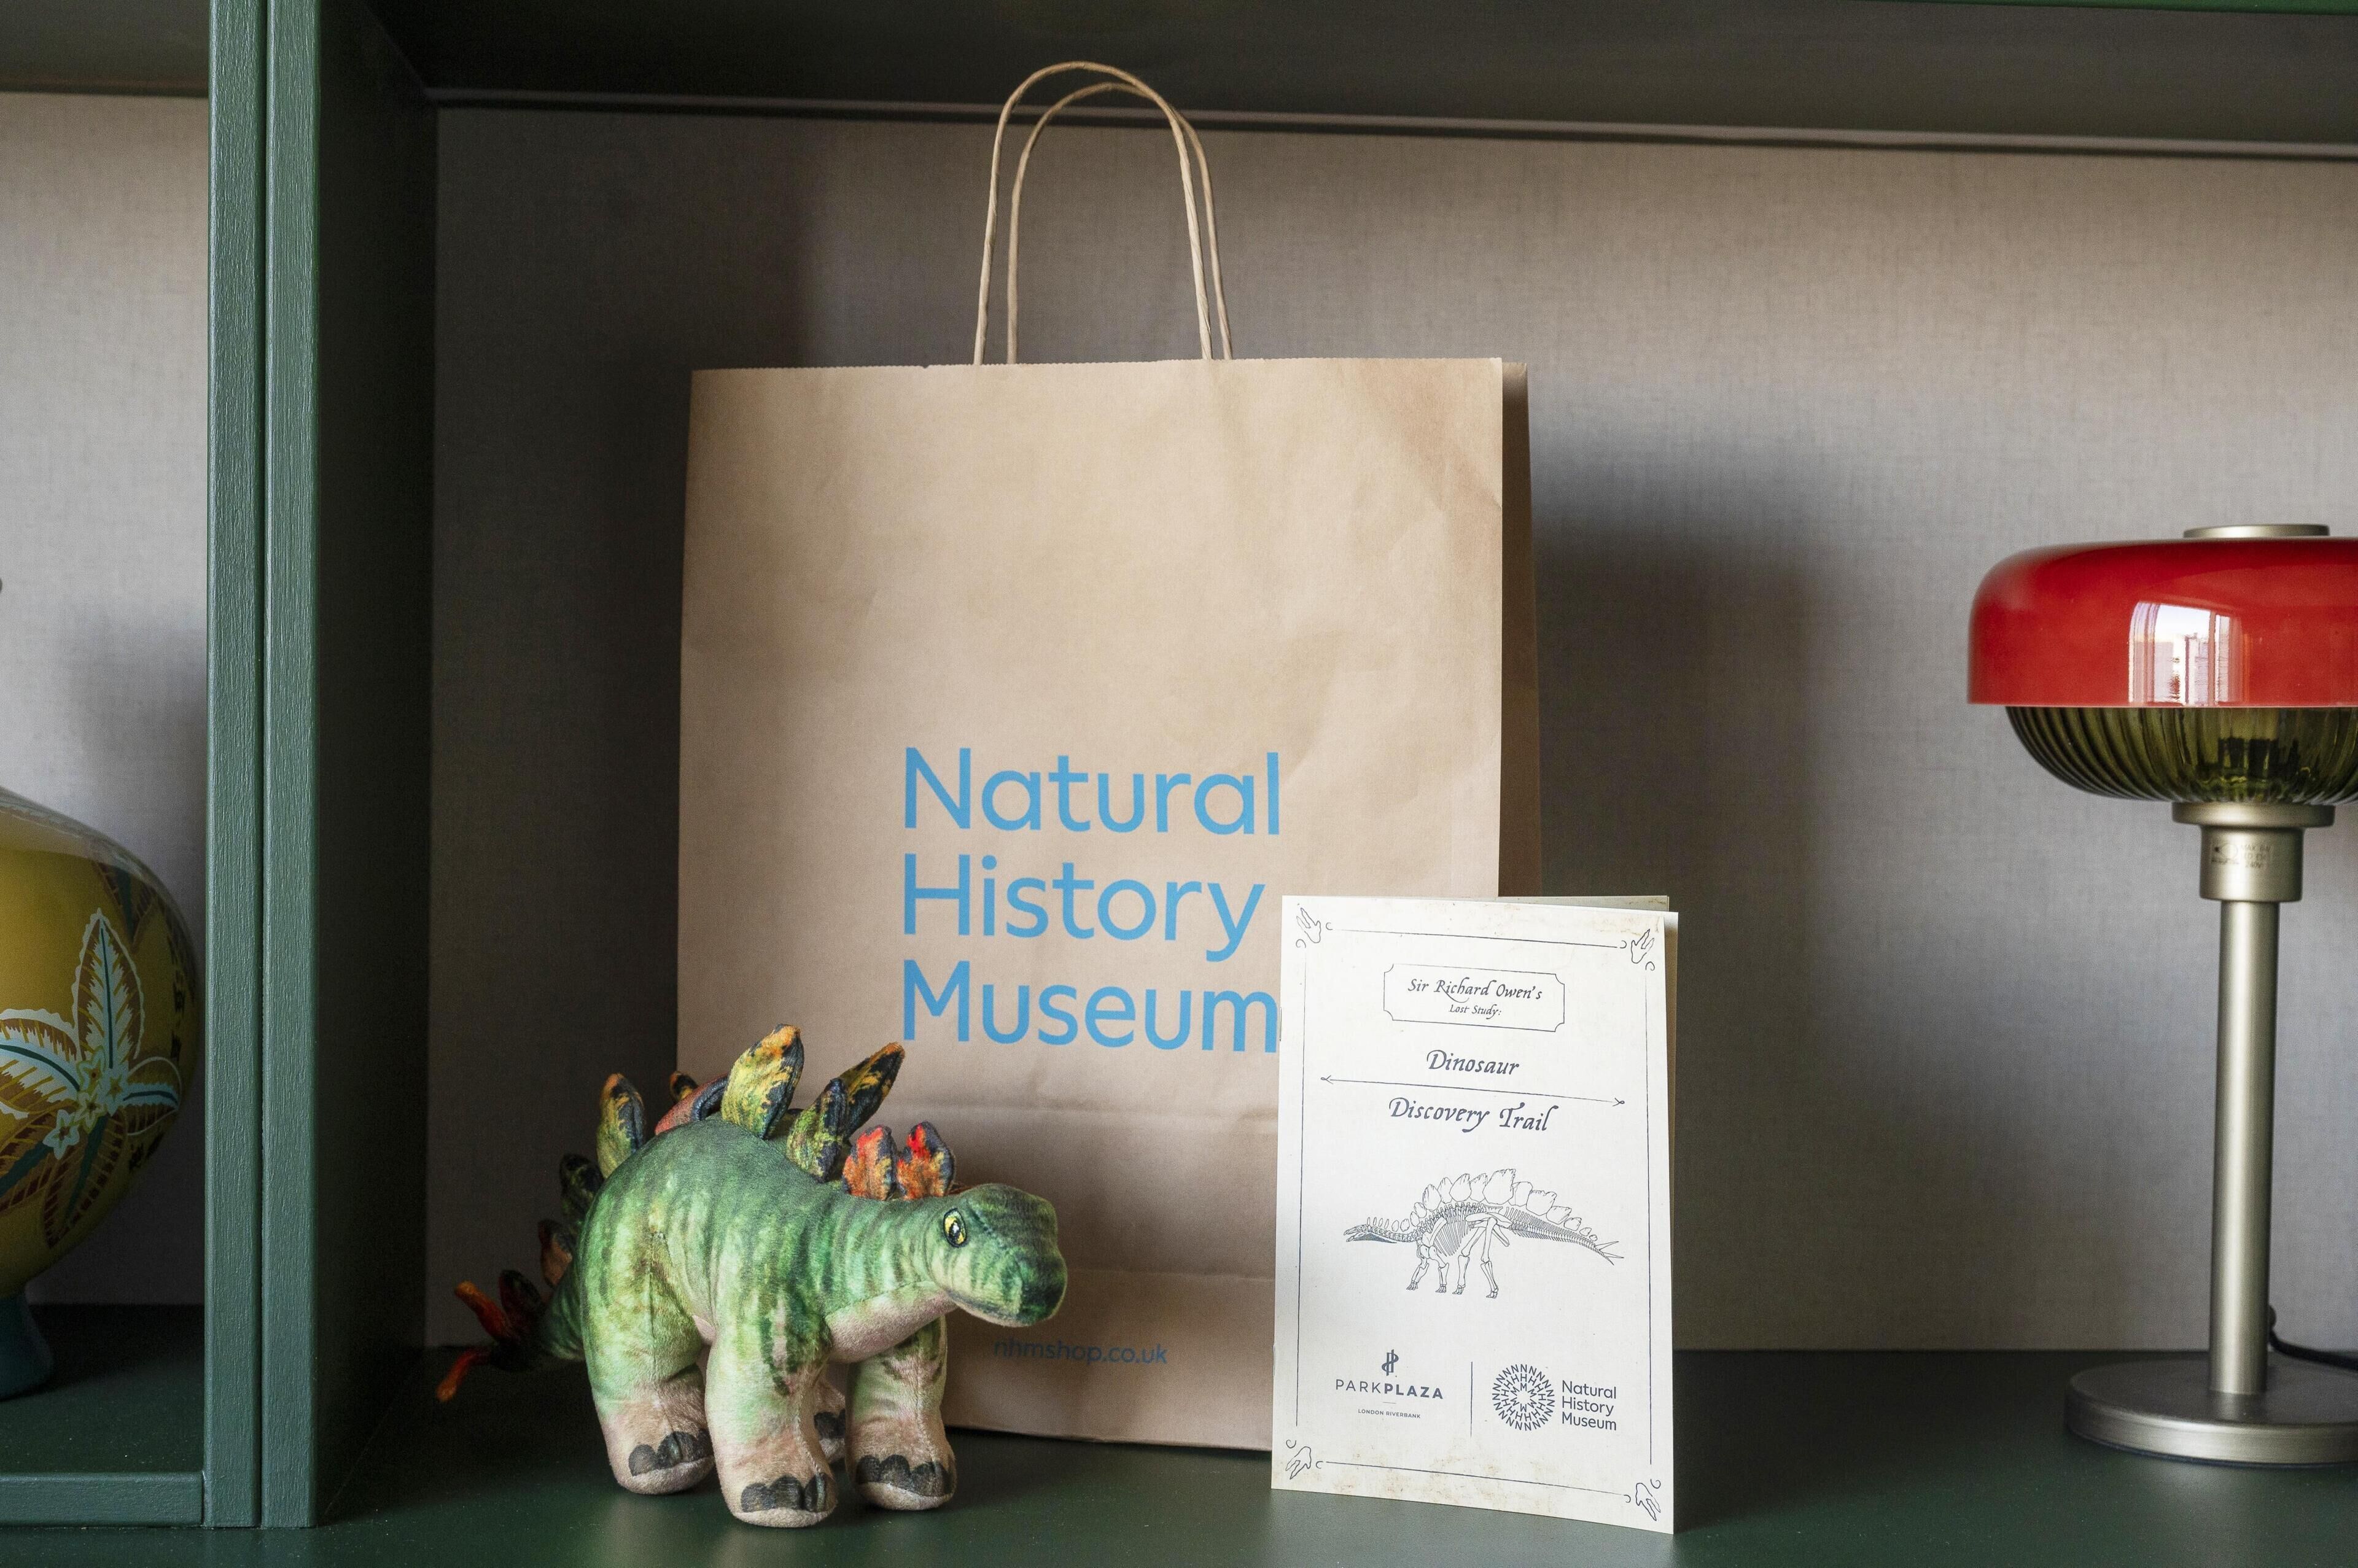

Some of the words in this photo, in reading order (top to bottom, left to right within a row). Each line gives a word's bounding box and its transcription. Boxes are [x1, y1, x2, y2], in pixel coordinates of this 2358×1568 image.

[904, 747, 1280, 836] Natural
[903, 853, 1266, 962] History
[1407, 978, 1430, 993] Sir
[1433, 977, 1498, 1003] Richard
[1495, 983, 1543, 1000] Owen's
[903, 959, 1278, 1054] Museum
[1448, 1004, 1469, 1014] Lost
[1471, 1004, 1502, 1020] Study:
[1426, 1049, 1520, 1075] Dinosaur
[1388, 1097, 1490, 1133] Discovery
[1499, 1102, 1559, 1131] Trail
[993, 1337, 1168, 1365] nhmshop.co.uk
[1562, 1380, 1617, 1399] Natural
[1562, 1395, 1614, 1417] History
[1562, 1411, 1617, 1431] Museum
